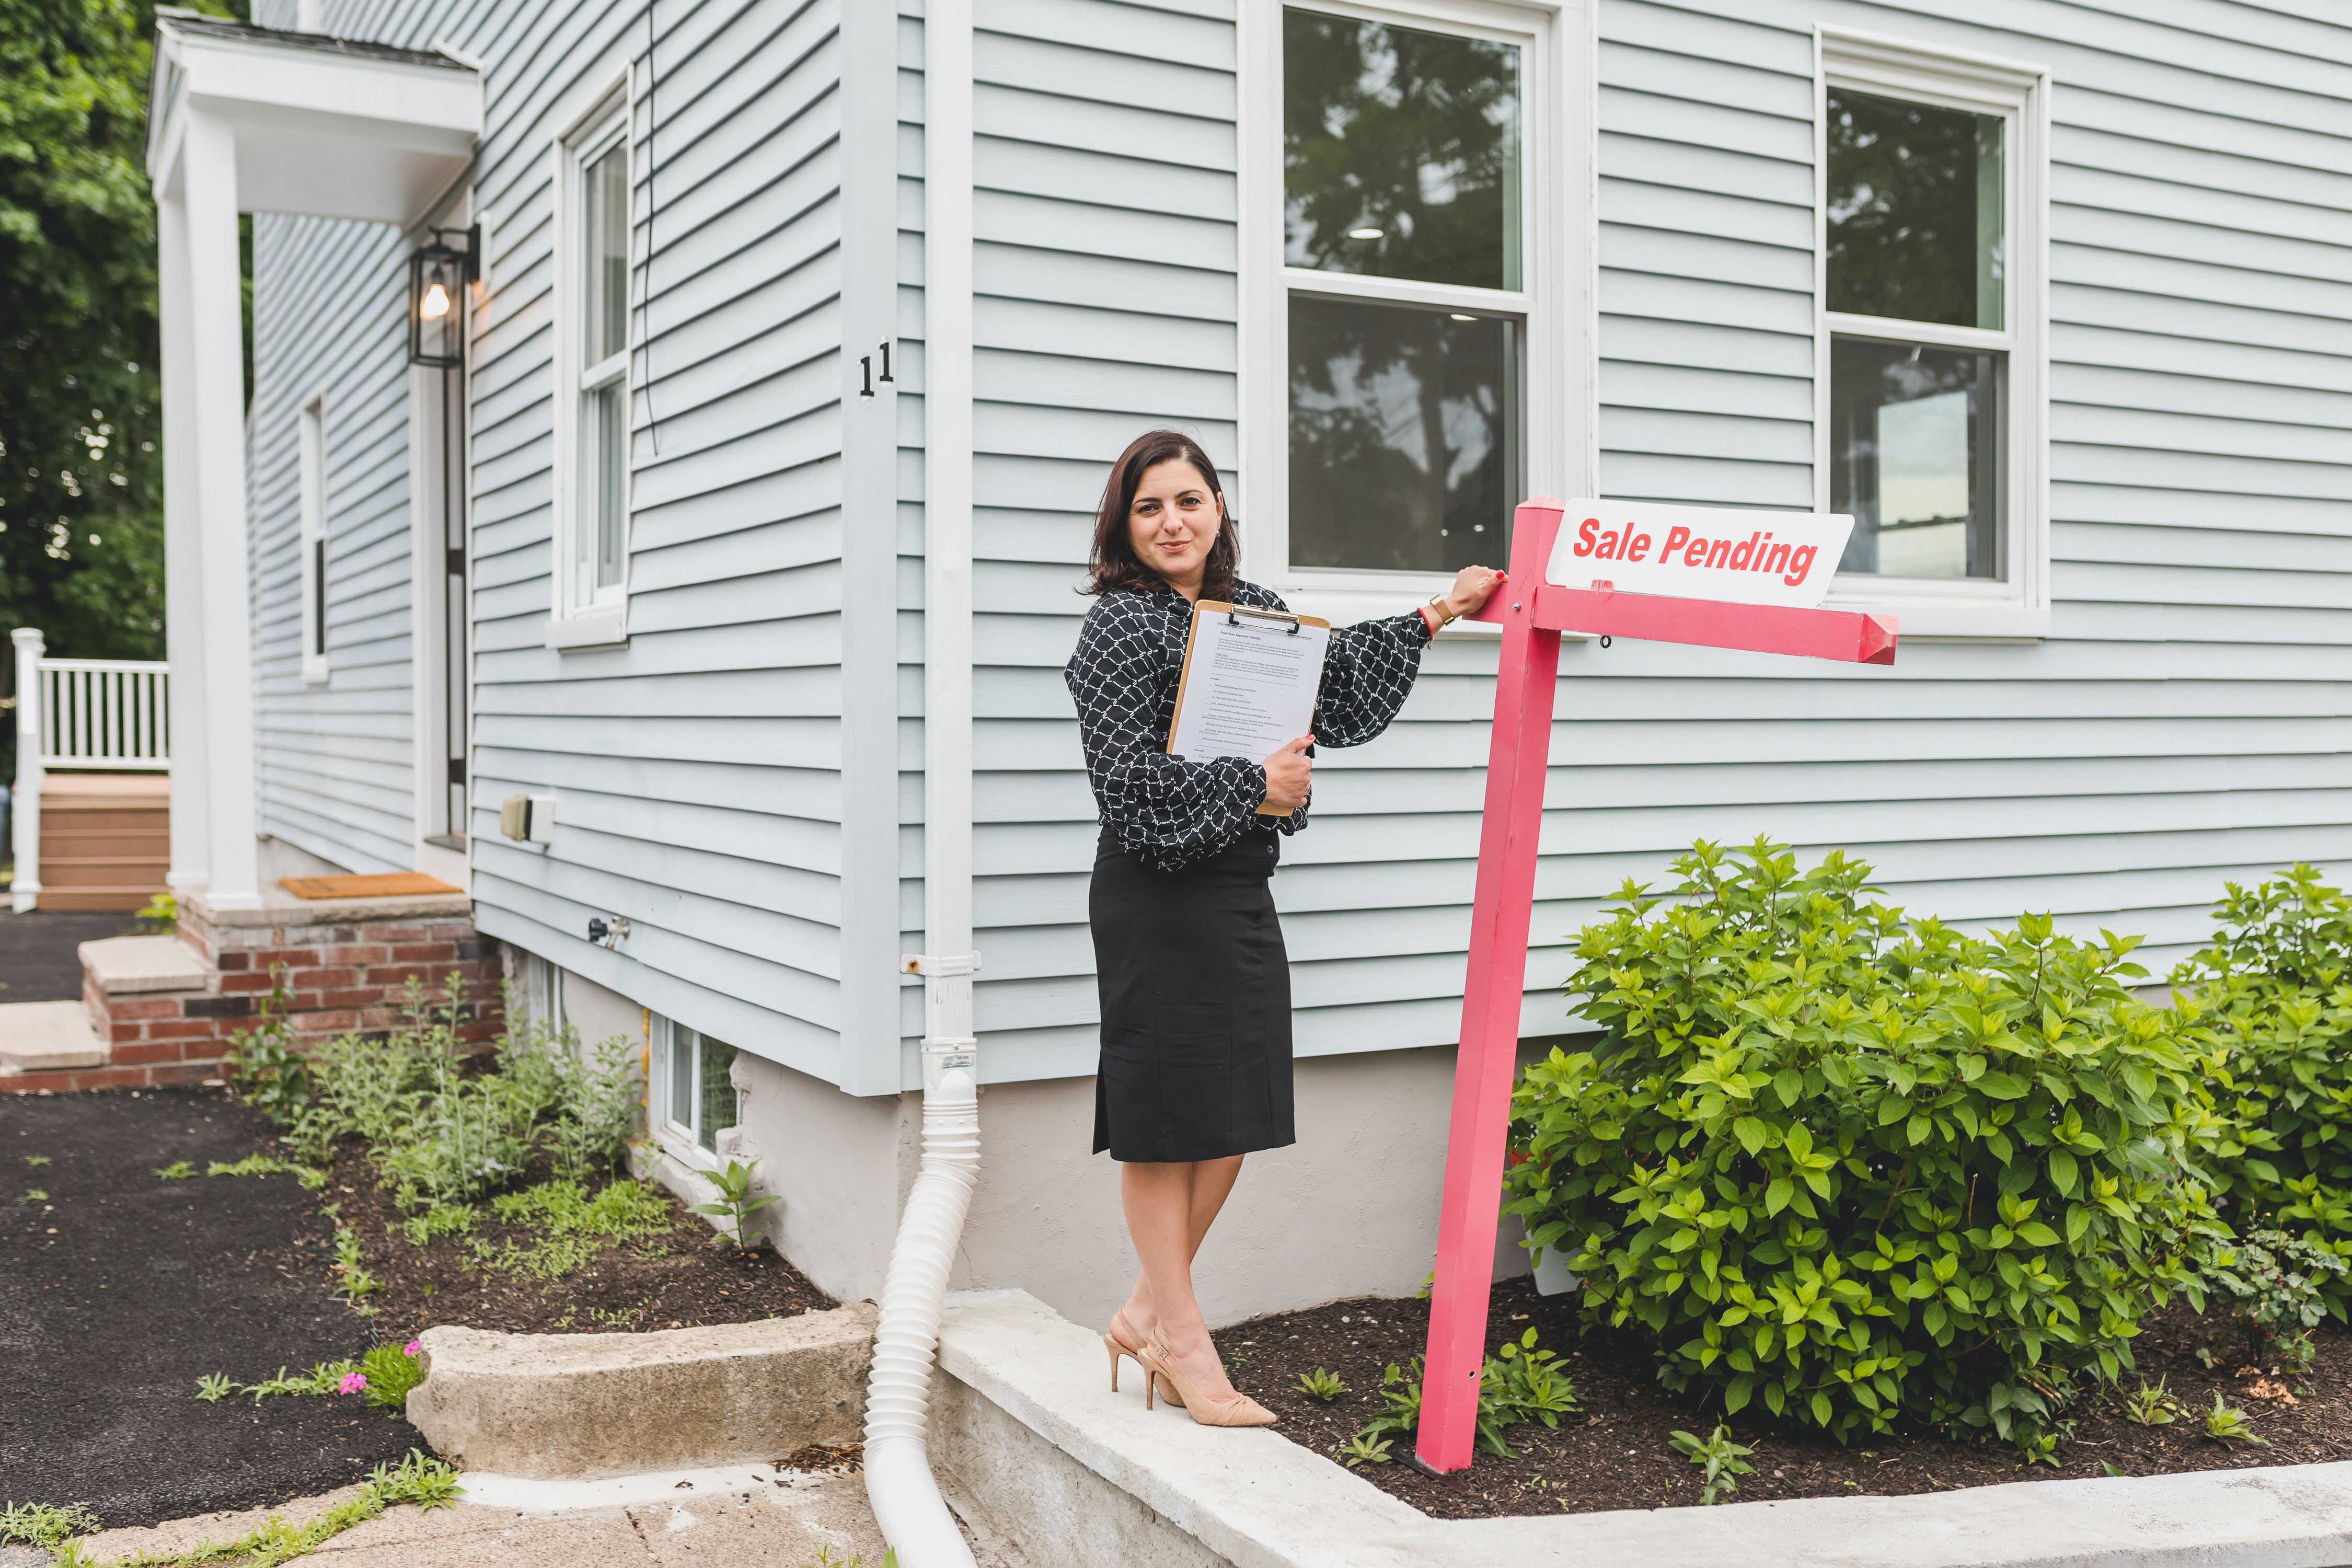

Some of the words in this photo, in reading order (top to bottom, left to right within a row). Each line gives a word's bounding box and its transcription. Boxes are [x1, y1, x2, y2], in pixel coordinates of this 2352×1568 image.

[860, 342, 893, 397] 11
[1573, 518, 1651, 562] Sale
[1658, 526, 1818, 586] Pending
